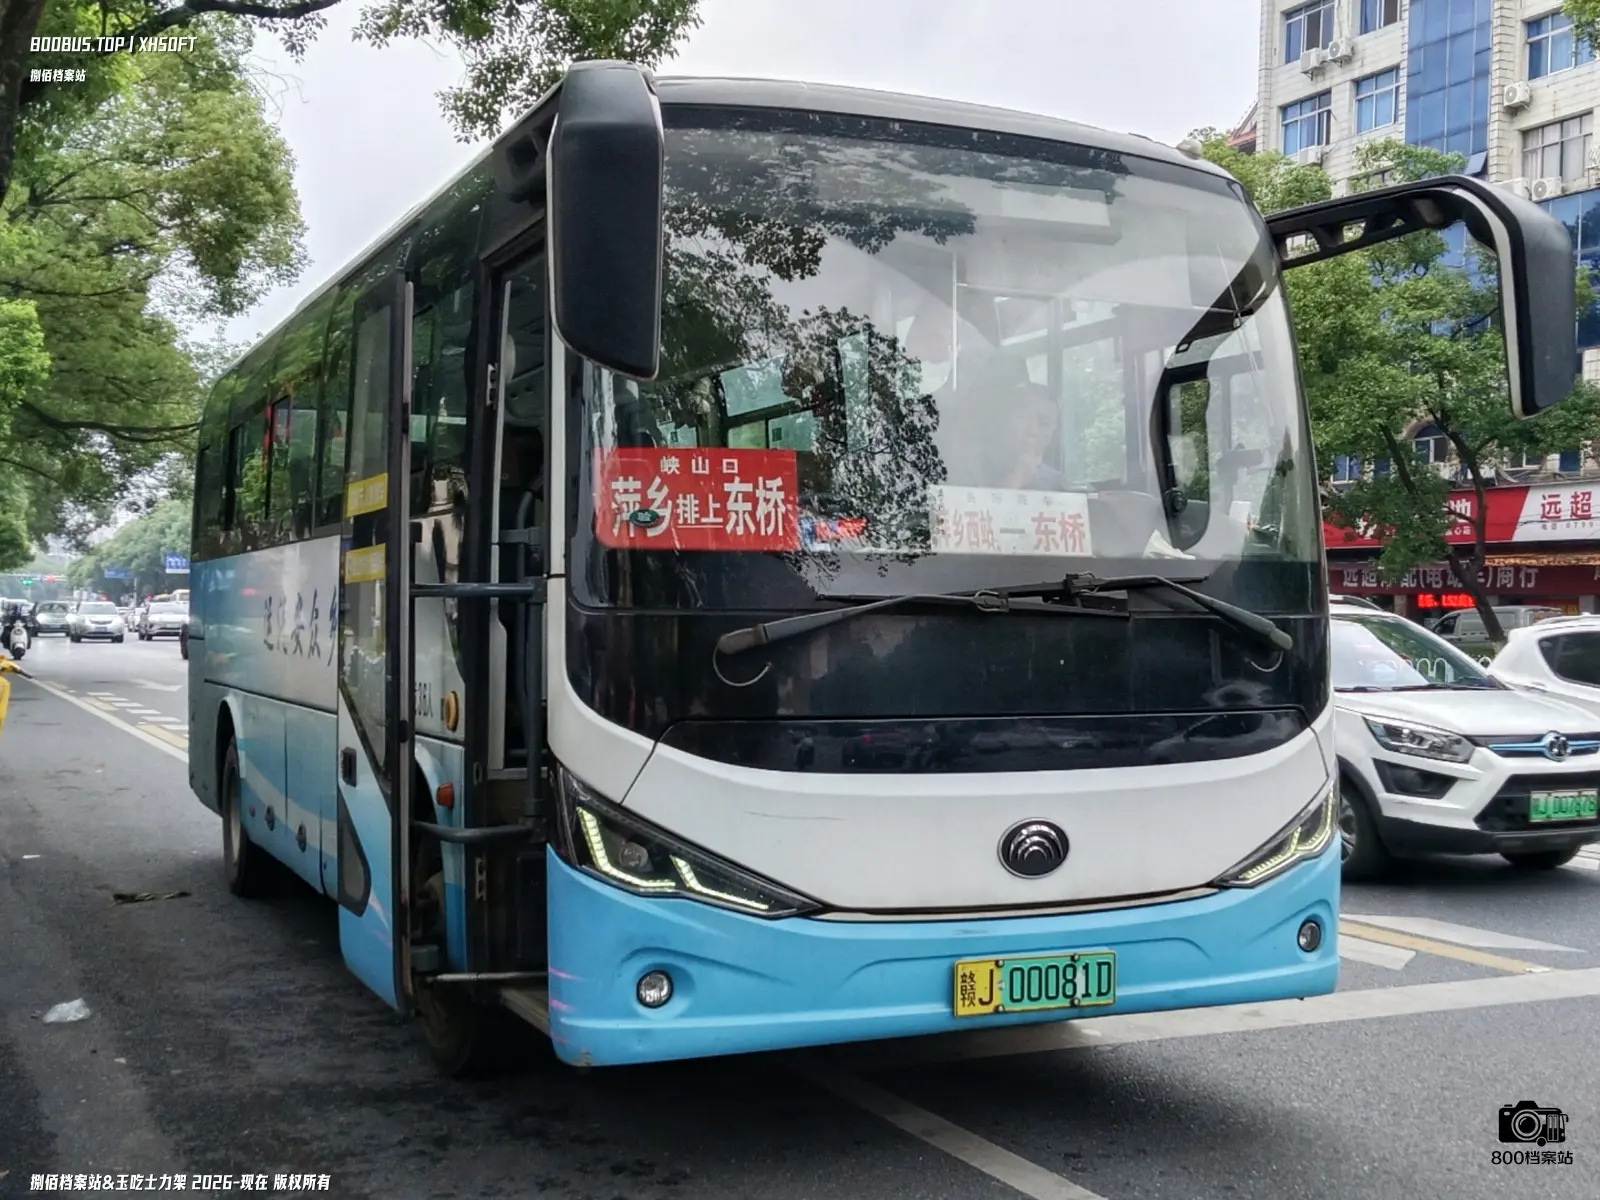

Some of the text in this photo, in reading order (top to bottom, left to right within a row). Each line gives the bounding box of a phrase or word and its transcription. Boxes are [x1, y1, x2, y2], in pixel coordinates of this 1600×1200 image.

[660, 455, 738, 475] 峡山口
[1540, 491, 1592, 520] 远超
